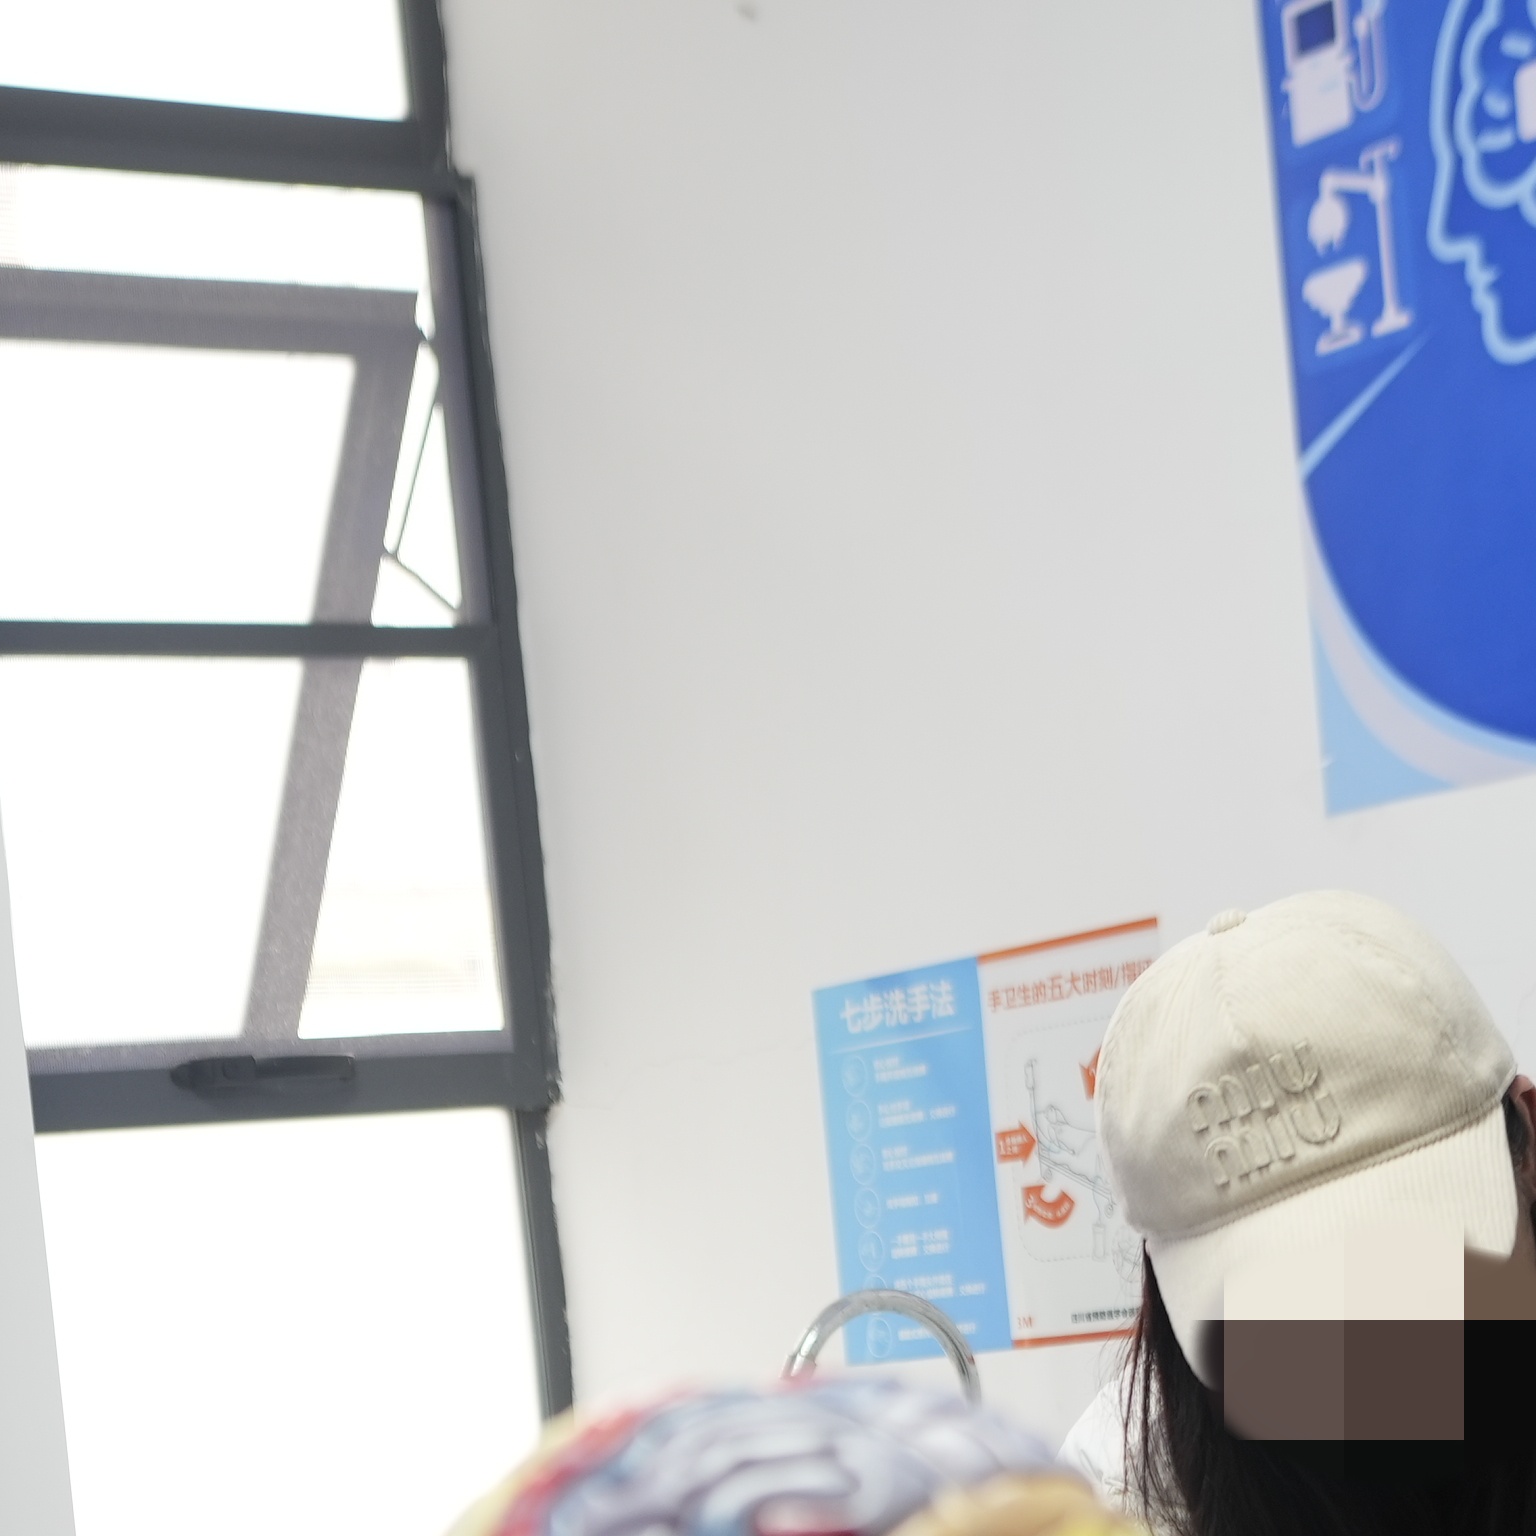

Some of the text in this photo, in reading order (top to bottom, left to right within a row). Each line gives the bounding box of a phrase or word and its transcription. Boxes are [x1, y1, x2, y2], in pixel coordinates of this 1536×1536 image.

[839, 978, 958, 1034] 七步洗手法
